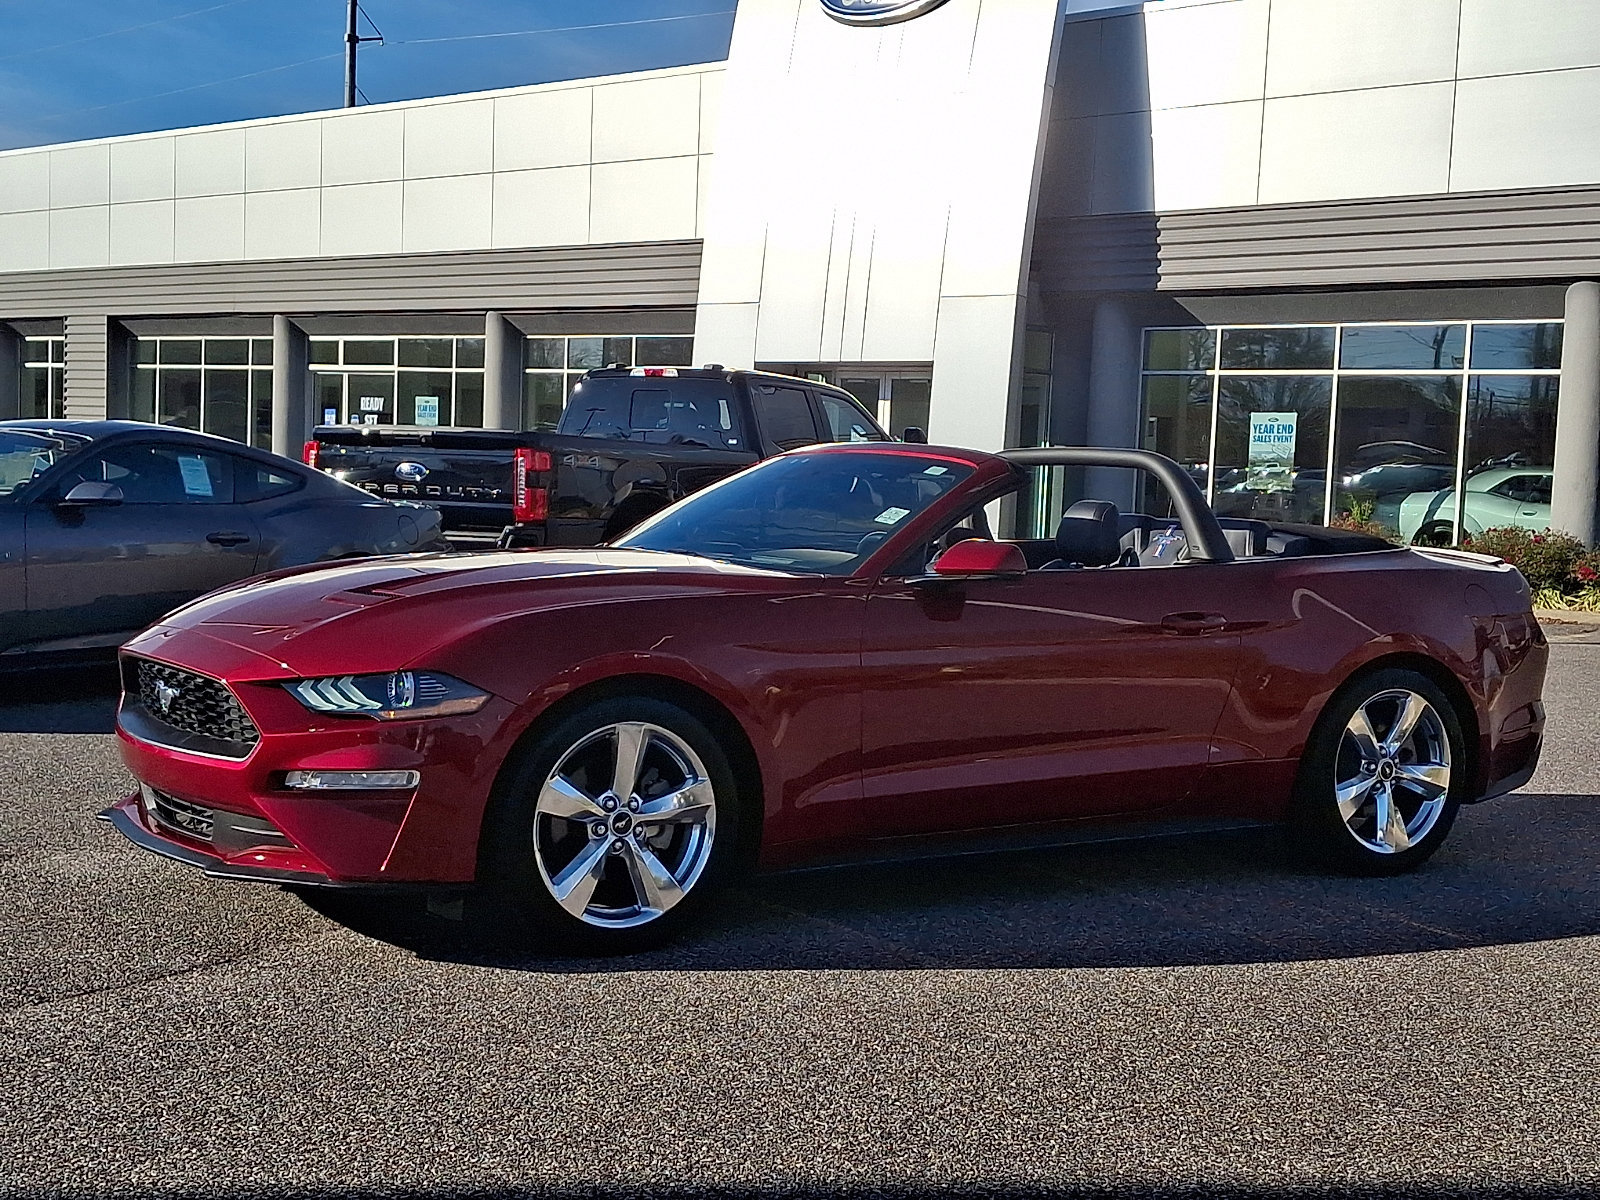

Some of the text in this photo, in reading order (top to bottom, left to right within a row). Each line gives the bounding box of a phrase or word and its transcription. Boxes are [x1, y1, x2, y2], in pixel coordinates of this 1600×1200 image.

[360, 396, 384, 411] READY
[1253, 424, 1294, 434] YEAR END
[1253, 435, 1292, 443] SALES EVENT
[426, 484, 502, 498] DUTY
